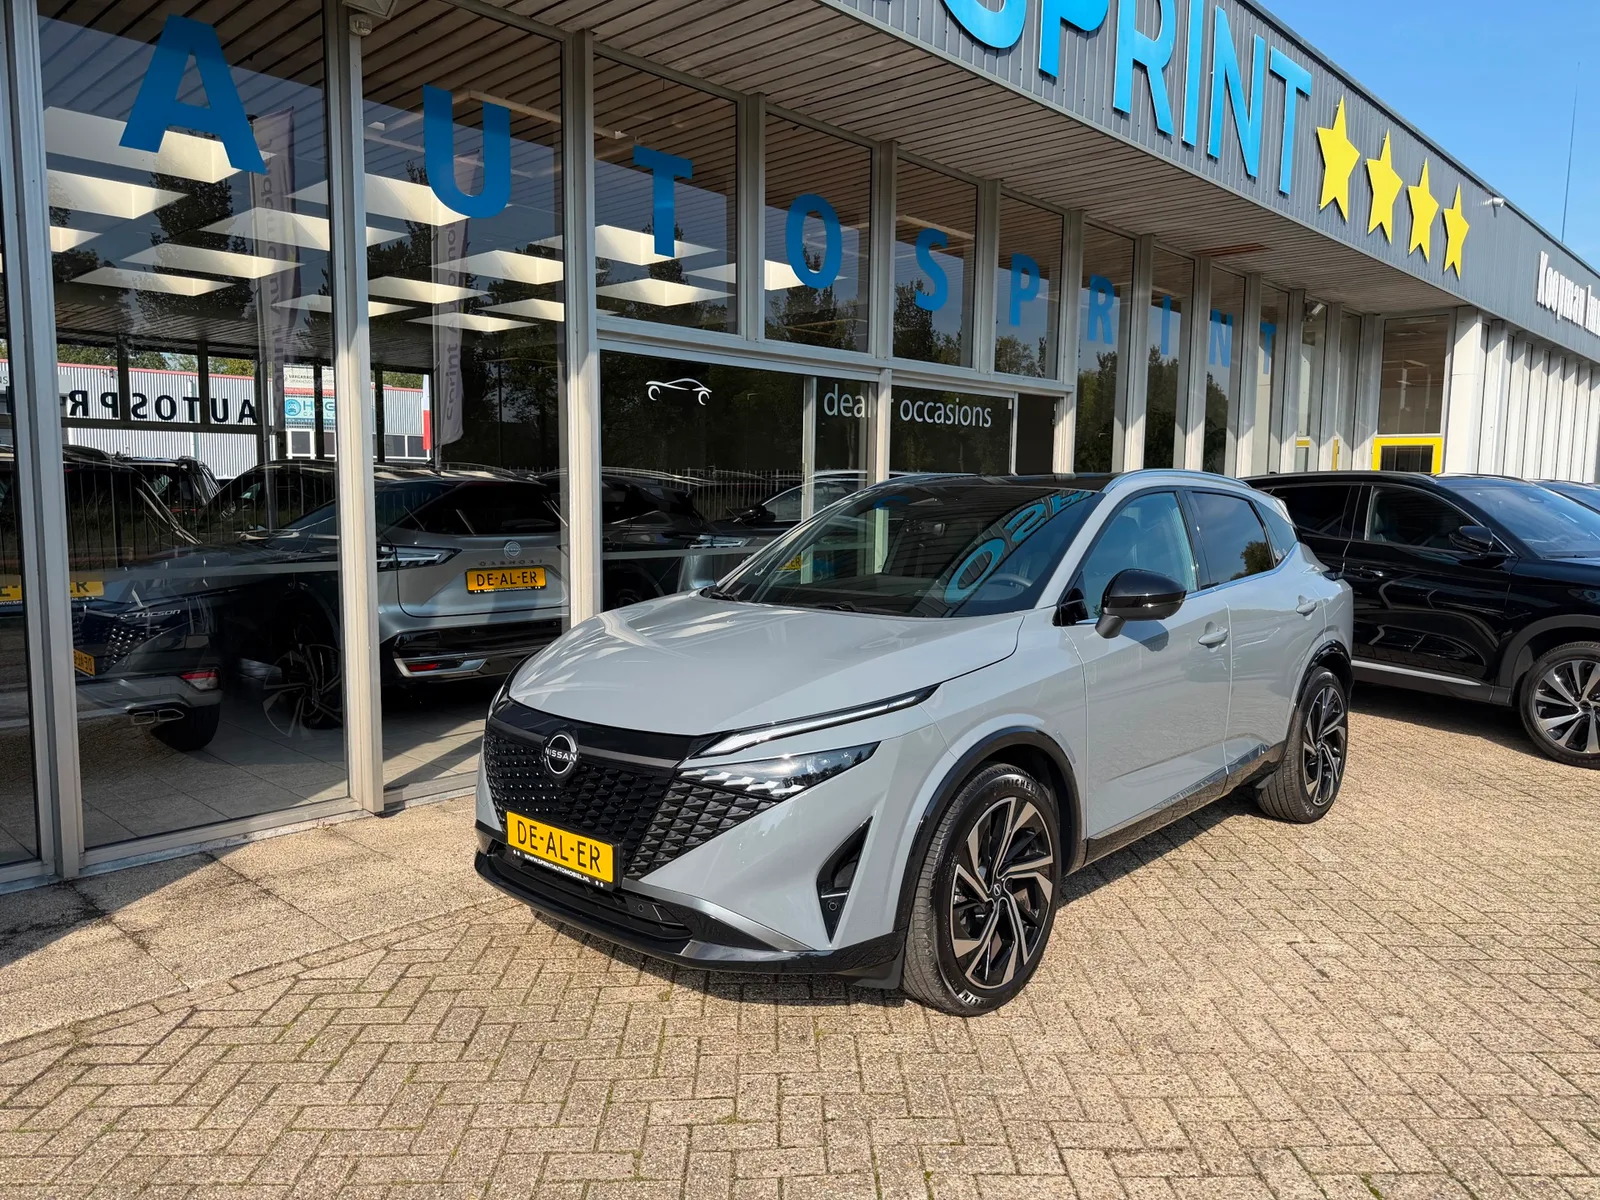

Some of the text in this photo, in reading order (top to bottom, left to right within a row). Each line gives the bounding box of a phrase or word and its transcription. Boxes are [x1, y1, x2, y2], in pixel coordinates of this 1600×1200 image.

[943, 0, 1312, 196] RINT
[823, 383, 992, 428] deal occasions
[476, 571, 537, 587] DE-AL-ER
[134, 608, 181, 619] Tucson
[545, 747, 577, 762] NISSAN
[517, 820, 601, 873] DE-AL-ER
